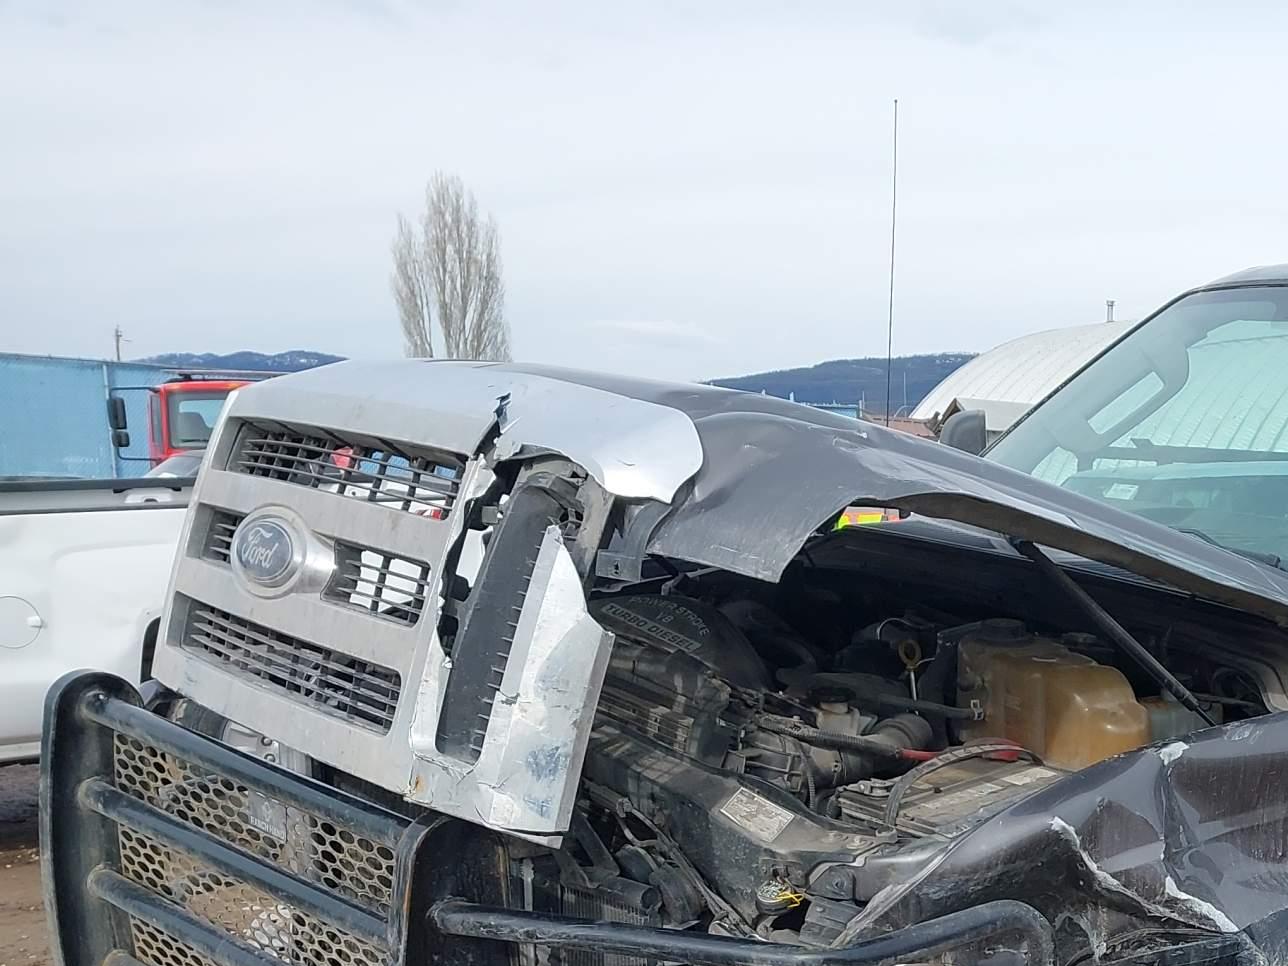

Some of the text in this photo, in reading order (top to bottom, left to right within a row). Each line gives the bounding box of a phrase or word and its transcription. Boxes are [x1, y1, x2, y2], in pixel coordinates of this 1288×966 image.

[241, 527, 278, 568] Ford
[606, 604, 695, 651] TURBO DIESEL
[656, 612, 674, 623] V8
